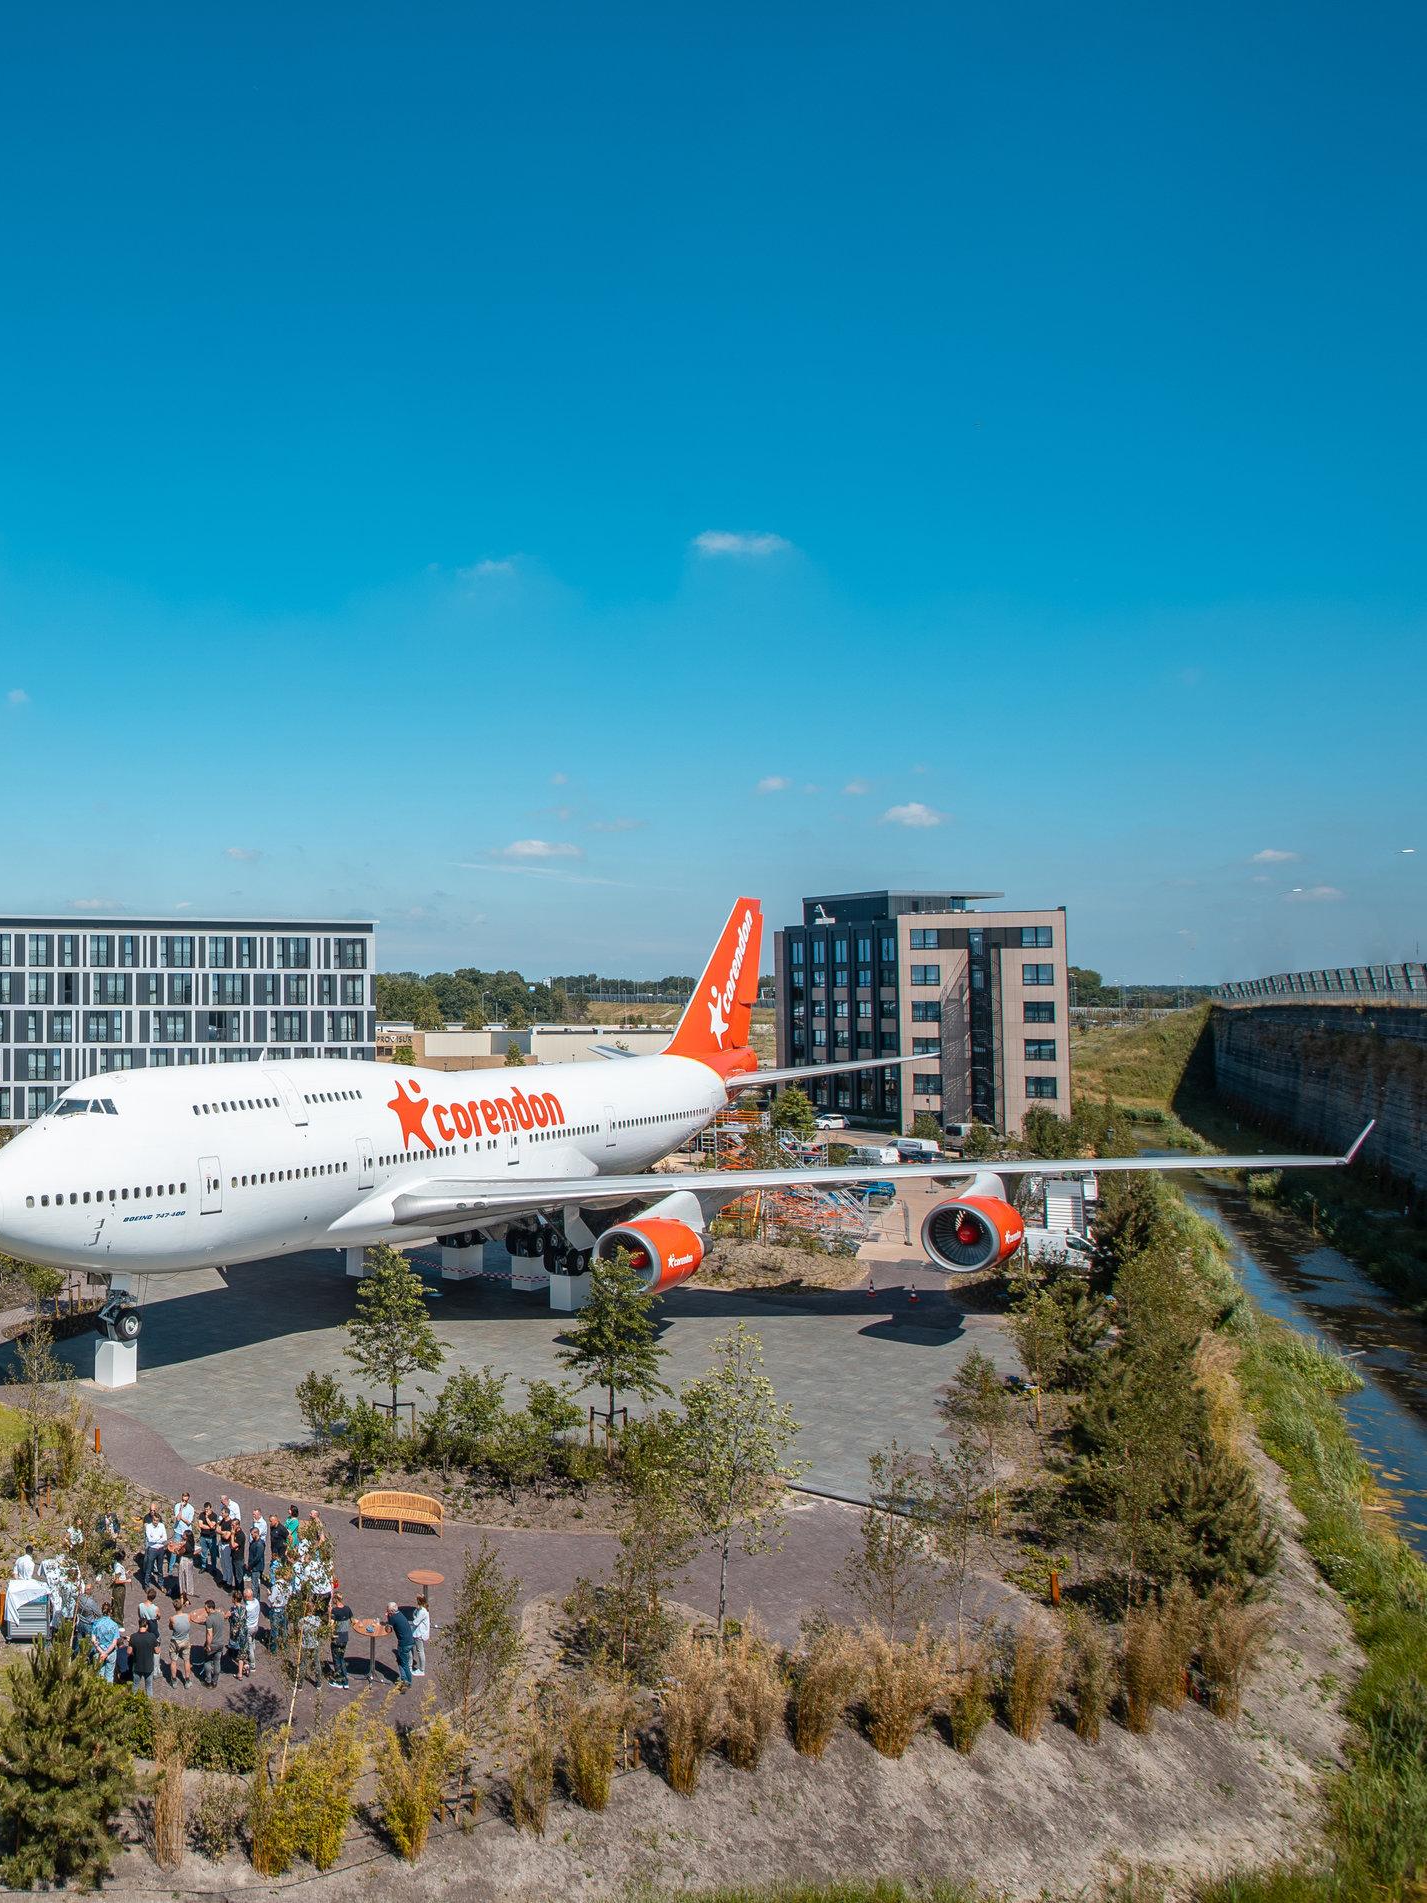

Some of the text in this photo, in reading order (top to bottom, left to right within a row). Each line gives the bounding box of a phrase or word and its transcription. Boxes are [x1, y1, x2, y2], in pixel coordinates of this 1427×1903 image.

[723, 909, 753, 1014] corendon
[376, 1035, 413, 1043] PROVISUR
[432, 1086, 565, 1142] corendon
[123, 1214, 153, 1222] BOEING
